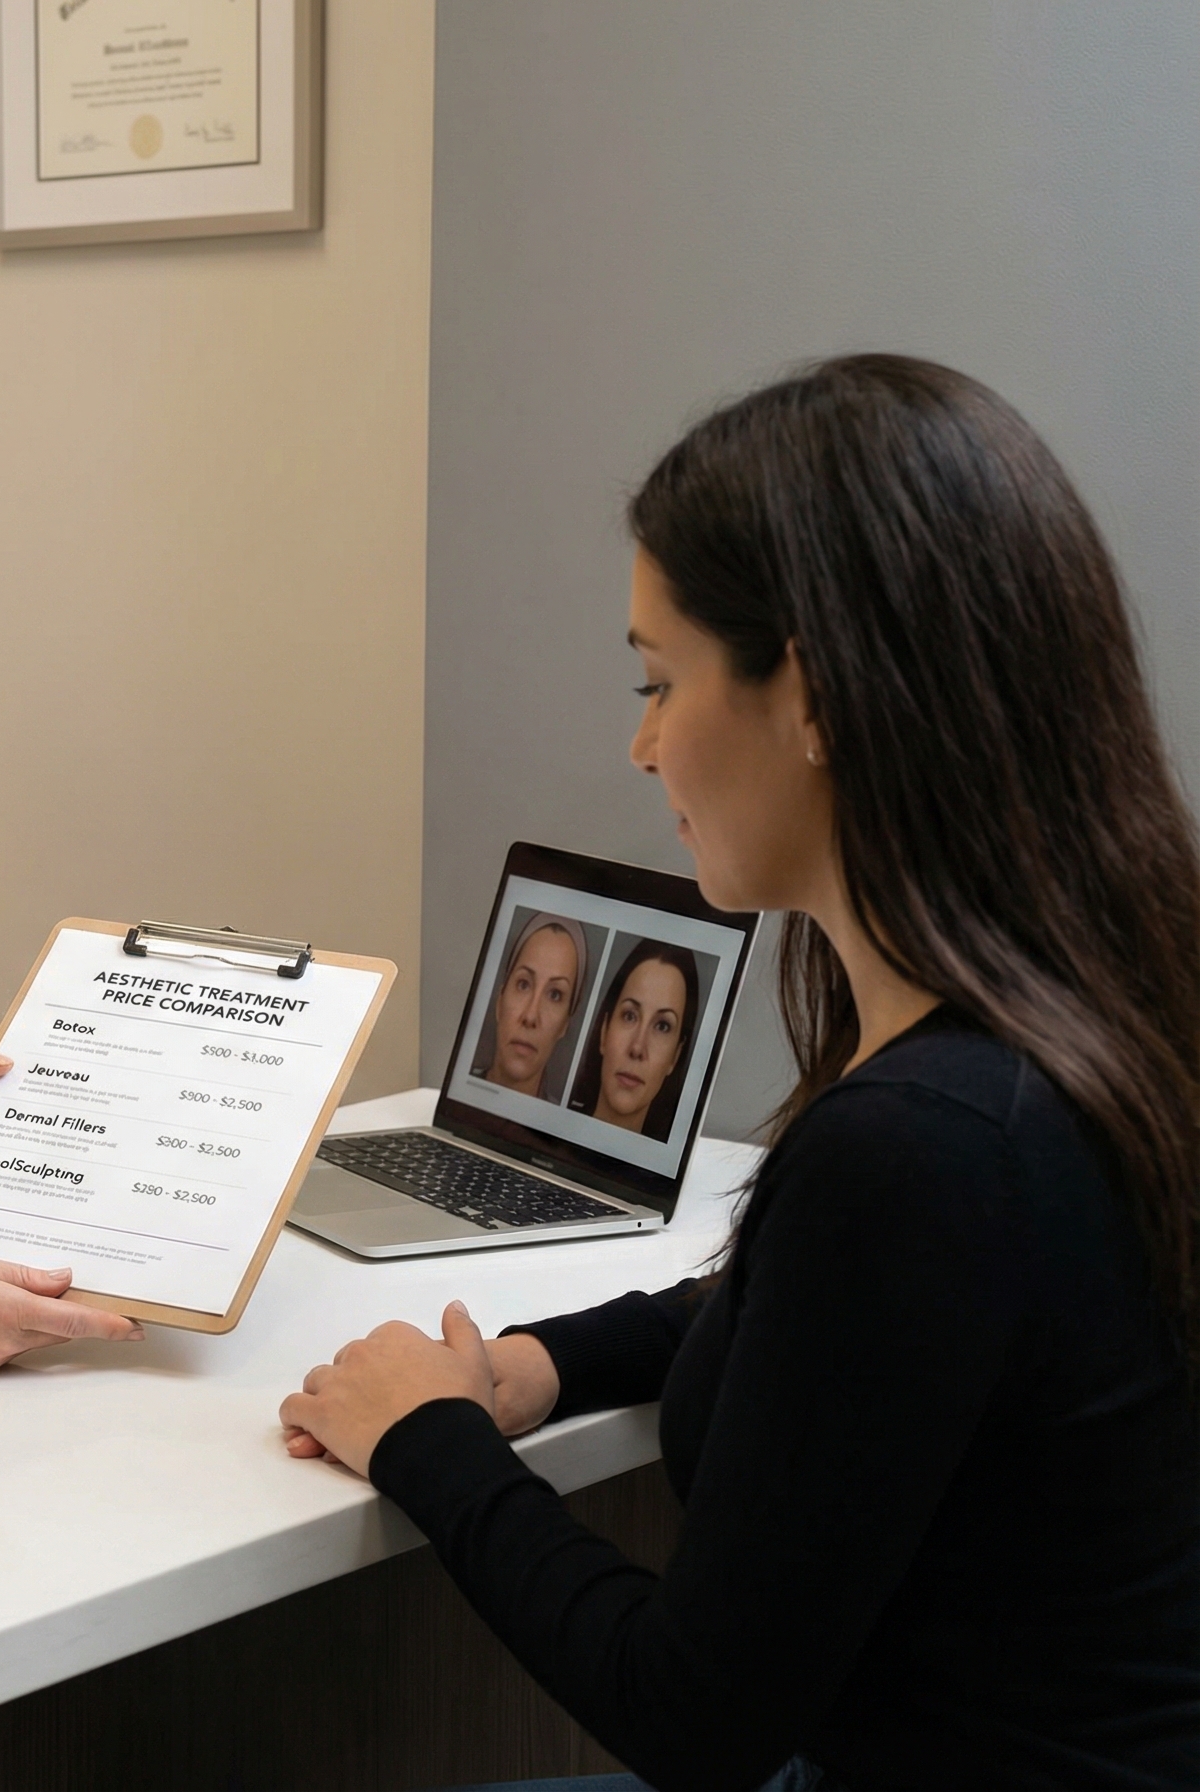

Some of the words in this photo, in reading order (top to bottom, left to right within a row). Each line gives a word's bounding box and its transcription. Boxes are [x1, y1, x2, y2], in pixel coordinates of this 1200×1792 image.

[93, 971, 194, 996] AESTHETIC
[198, 985, 310, 1013] TREATMENT
[102, 989, 155, 1008] PRICE
[159, 997, 285, 1027] COMPARISON
[52, 1019, 97, 1035] Botox
[27, 1063, 90, 1083] Jeuveau
[4, 1107, 60, 1127] Dermal
[61, 1116, 107, 1134] Fillers
